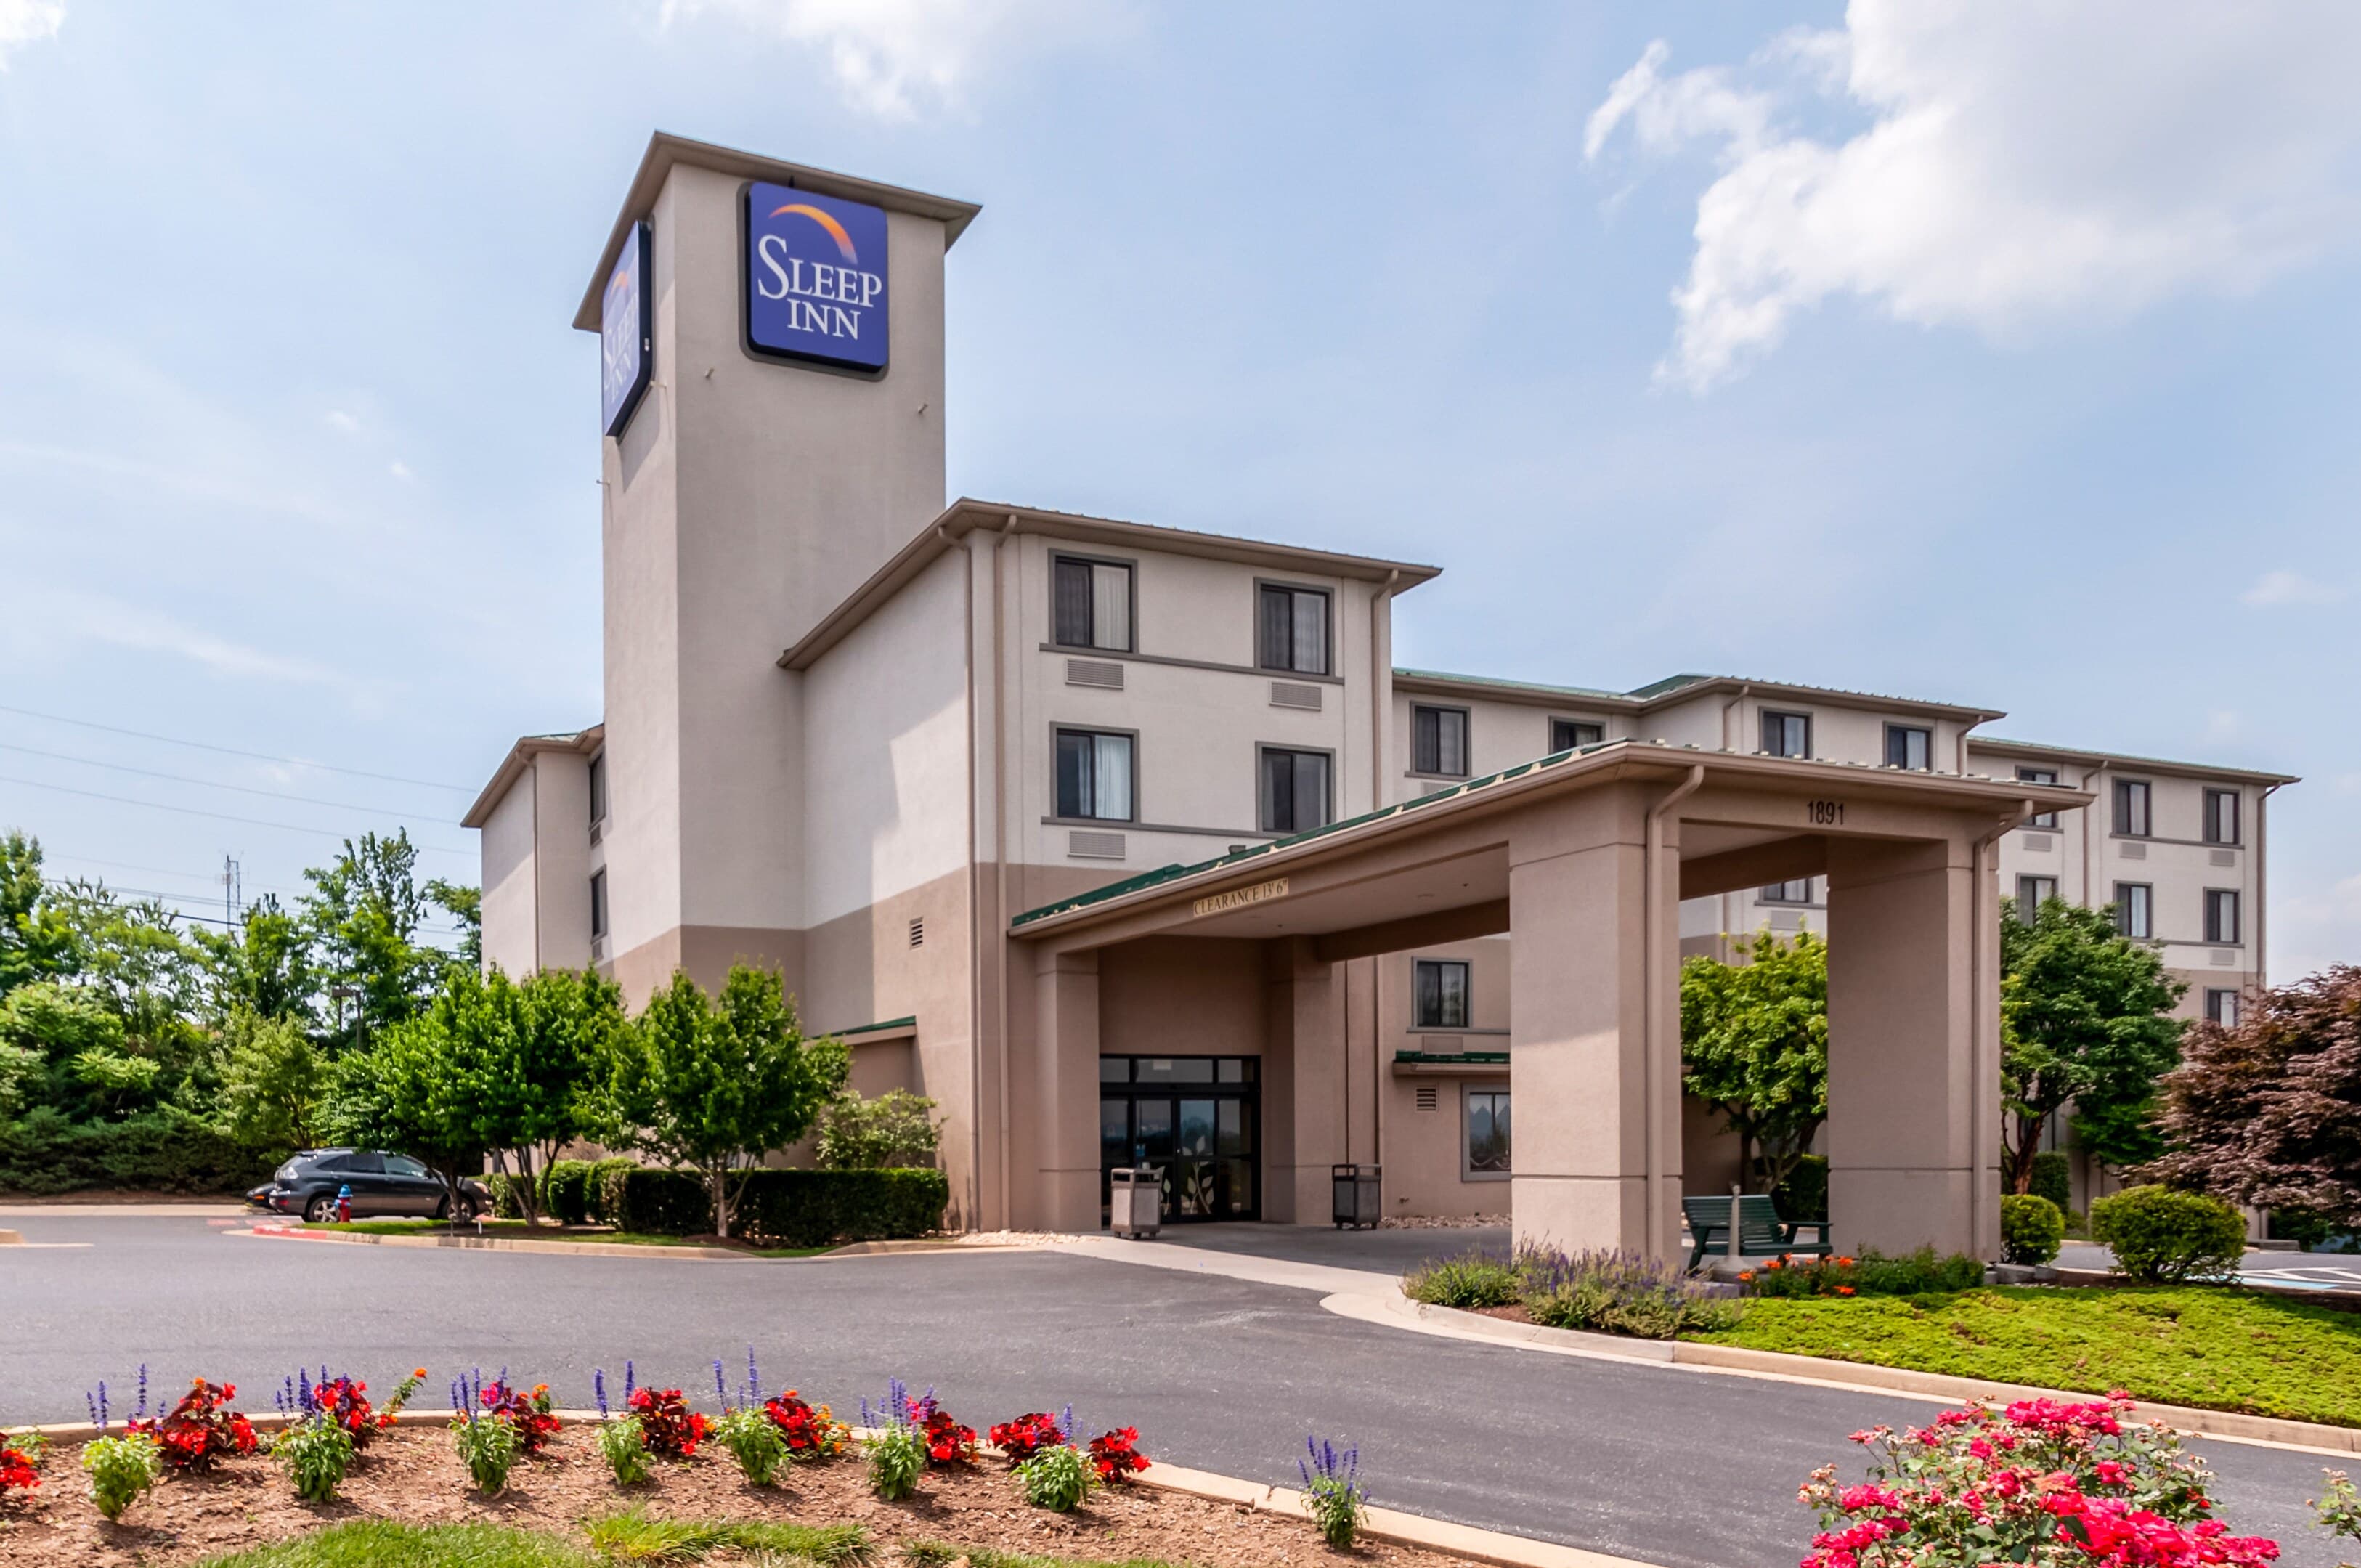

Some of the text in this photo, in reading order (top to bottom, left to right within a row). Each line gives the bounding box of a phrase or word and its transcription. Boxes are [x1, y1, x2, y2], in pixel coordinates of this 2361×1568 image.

[757, 234, 882, 307] SLEEP
[787, 298, 861, 340] INN
[1806, 800, 1844, 825] 1891
[1195, 879, 1288, 915] CLEARANCE 13' 6"
